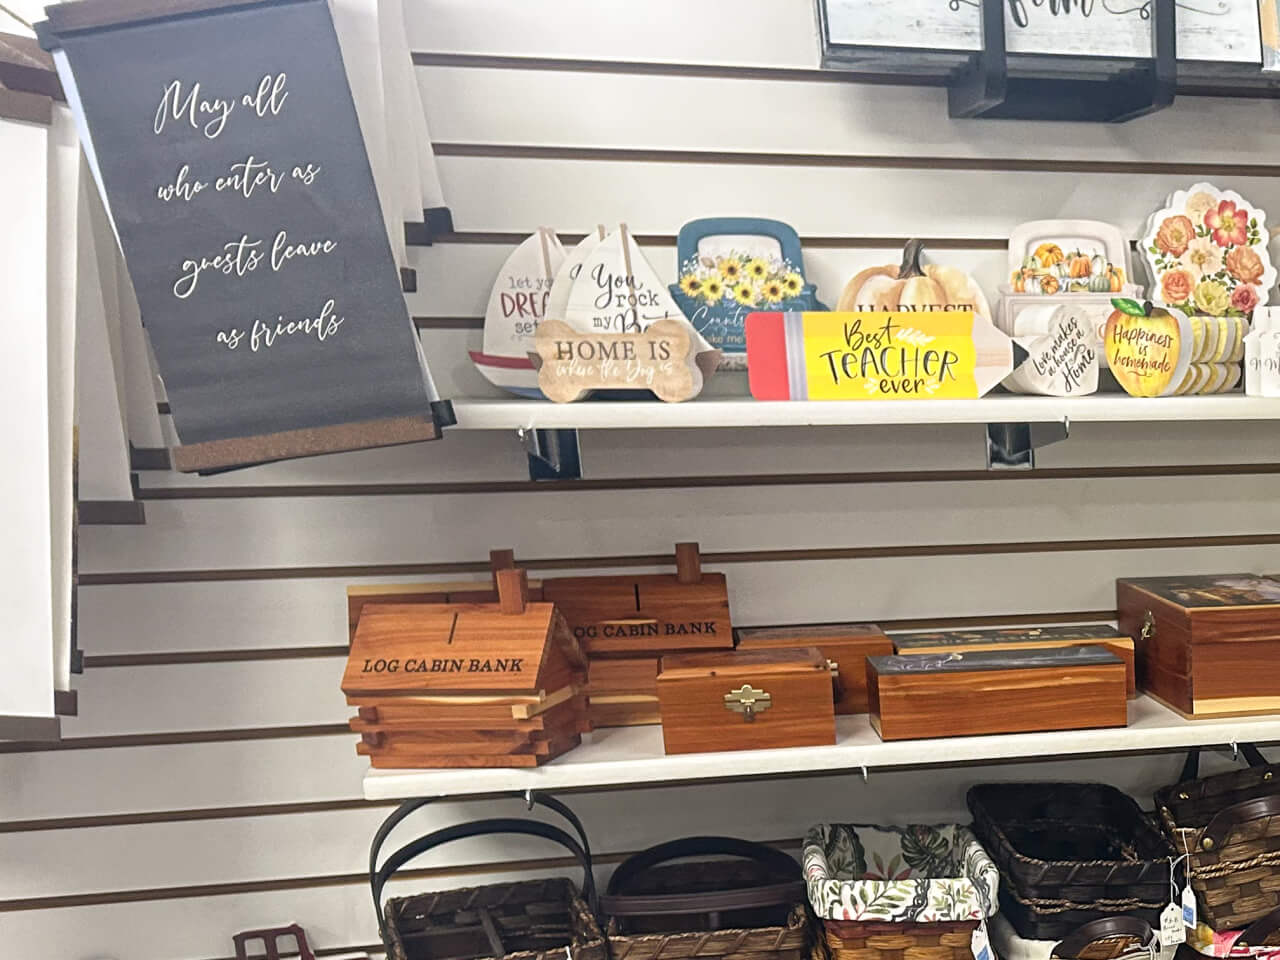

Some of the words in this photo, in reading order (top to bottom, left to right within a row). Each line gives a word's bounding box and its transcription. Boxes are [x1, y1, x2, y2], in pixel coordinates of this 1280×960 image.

[153, 79, 235, 139] May
[241, 72, 290, 111] all
[157, 164, 207, 202] who
[214, 155, 286, 194] enter
[291, 162, 321, 184] as
[172, 234, 265, 299] guests
[270, 230, 338, 271] leave
[591, 263, 644, 310] You
[615, 289, 661, 308] rock
[216, 326, 245, 351] as
[249, 299, 345, 354] friends
[593, 315, 612, 331] my
[843, 316, 901, 350] Best
[1113, 323, 1175, 349] Happiness
[555, 340, 637, 360] HOME
[648, 339, 671, 361] IS
[1032, 351, 1051, 377] Love
[1051, 316, 1079, 355] makes
[1052, 338, 1078, 368] house
[1138, 342, 1149, 357] is
[1062, 344, 1096, 393] Home
[1114, 350, 1172, 375] homemade
[878, 378, 926, 395] ever
[574, 624, 598, 639] OG
[602, 622, 659, 639] CABIN
[664, 620, 717, 636] BANK
[362, 659, 399, 674] LOG
[404, 658, 465, 674] CABIN
[467, 657, 524, 674] BANK
